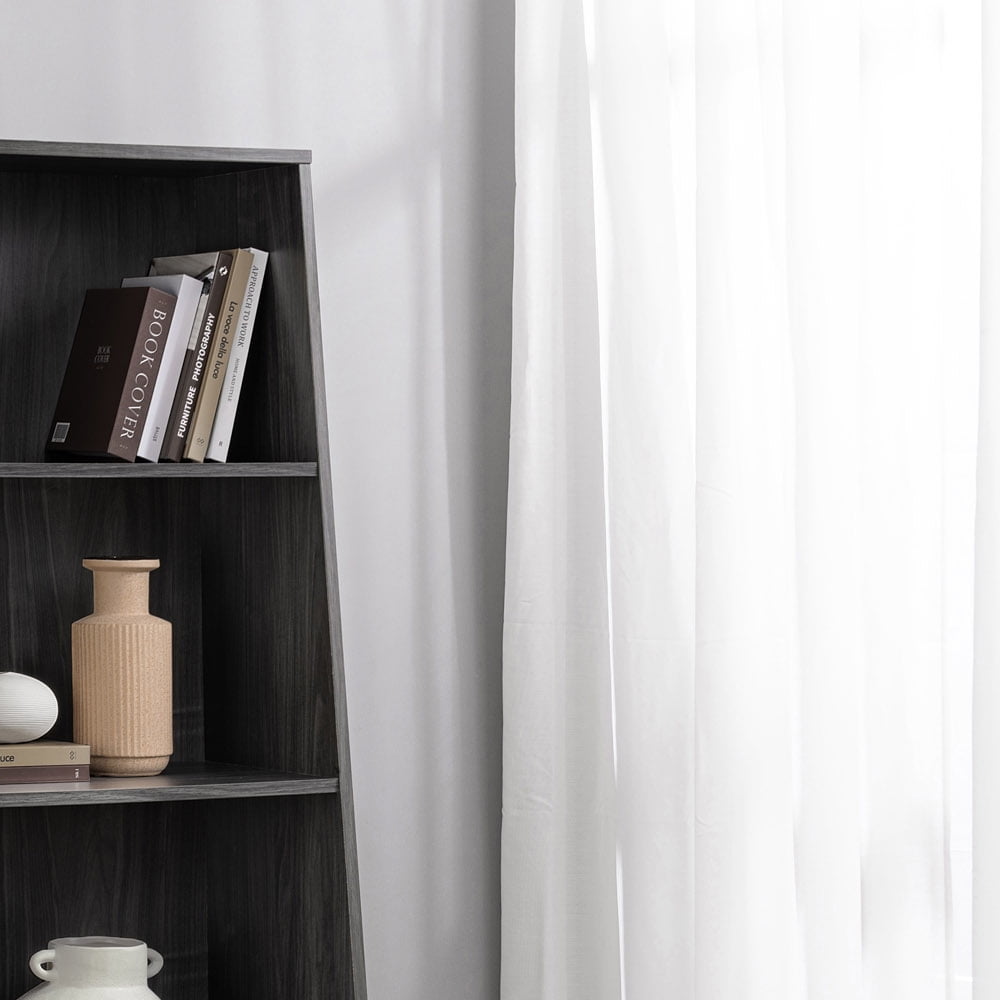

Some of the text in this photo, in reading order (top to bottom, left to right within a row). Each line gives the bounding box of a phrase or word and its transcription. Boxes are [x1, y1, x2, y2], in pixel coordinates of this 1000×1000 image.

[212, 301, 238, 379] La voce della luce
[237, 265, 260, 347] APPROACH TO WORK
[120, 309, 167, 439] BOOK COVER
[177, 313, 216, 438] FURNITURE PHOTOGRAPHY
